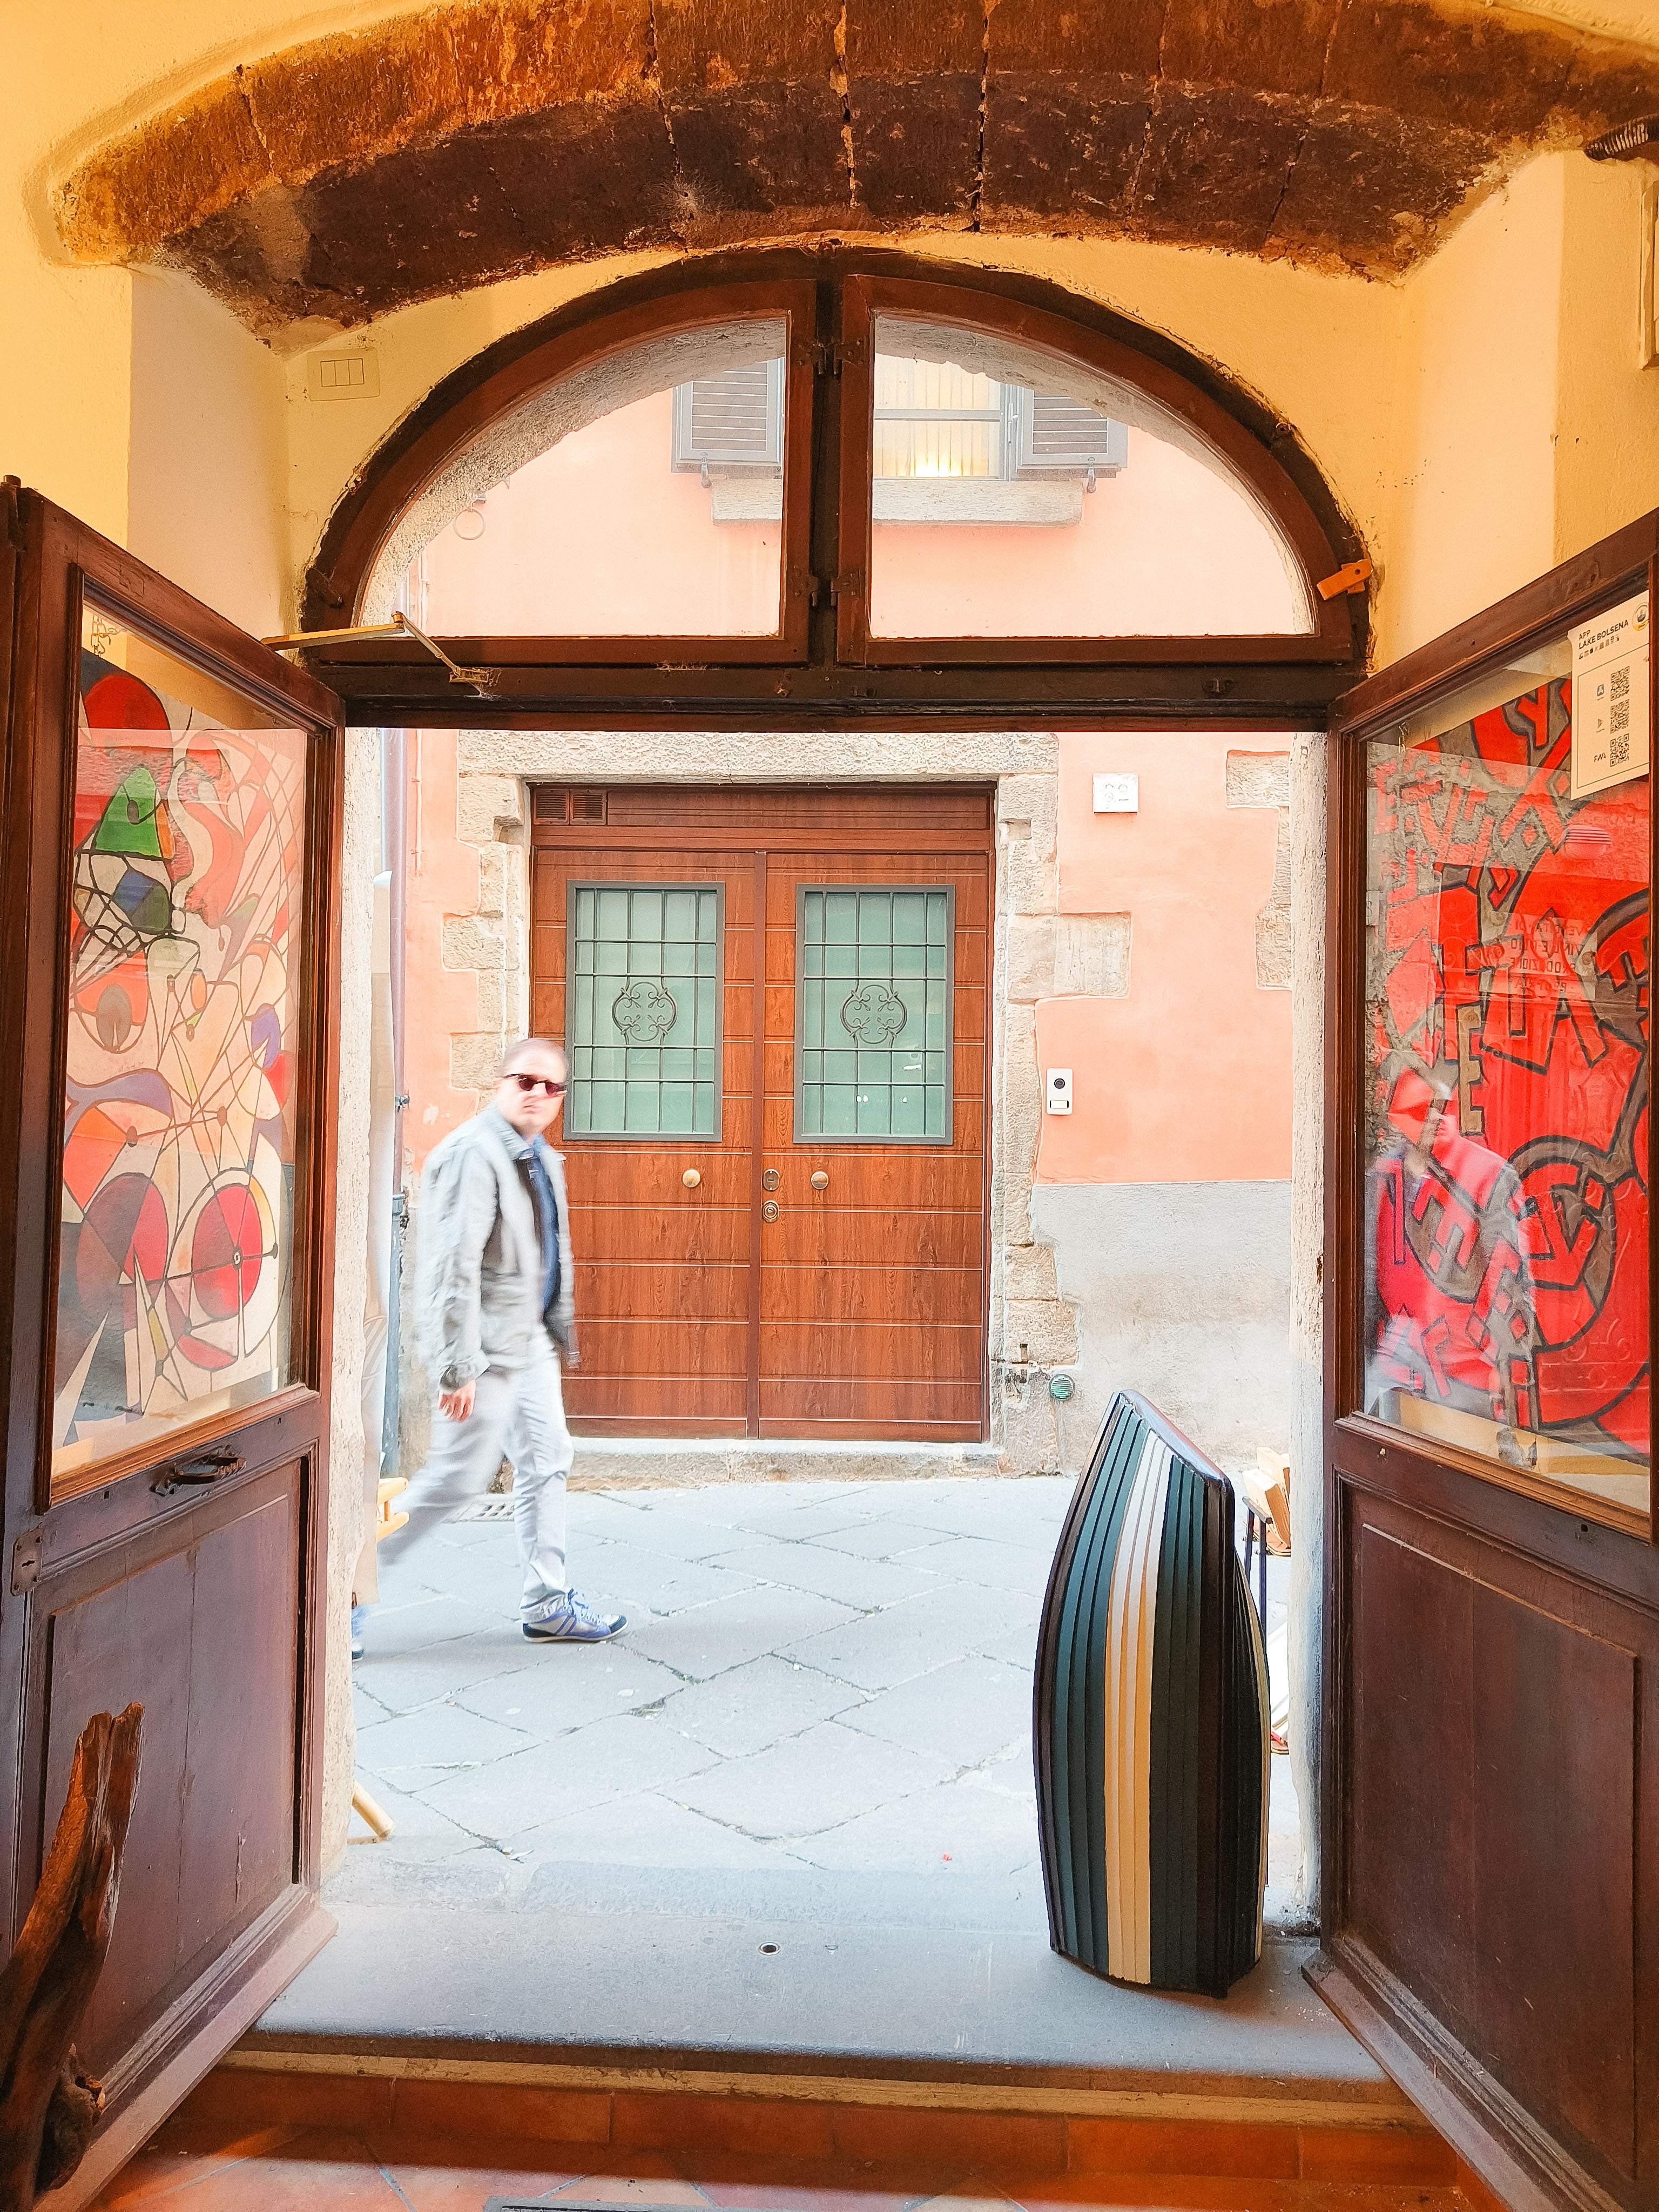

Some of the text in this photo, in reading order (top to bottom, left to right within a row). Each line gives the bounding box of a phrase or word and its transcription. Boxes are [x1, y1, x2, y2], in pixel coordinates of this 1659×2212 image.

[1579, 619, 1629, 649] LAKE BOLSENA
[1579, 630, 1591, 640] APP
